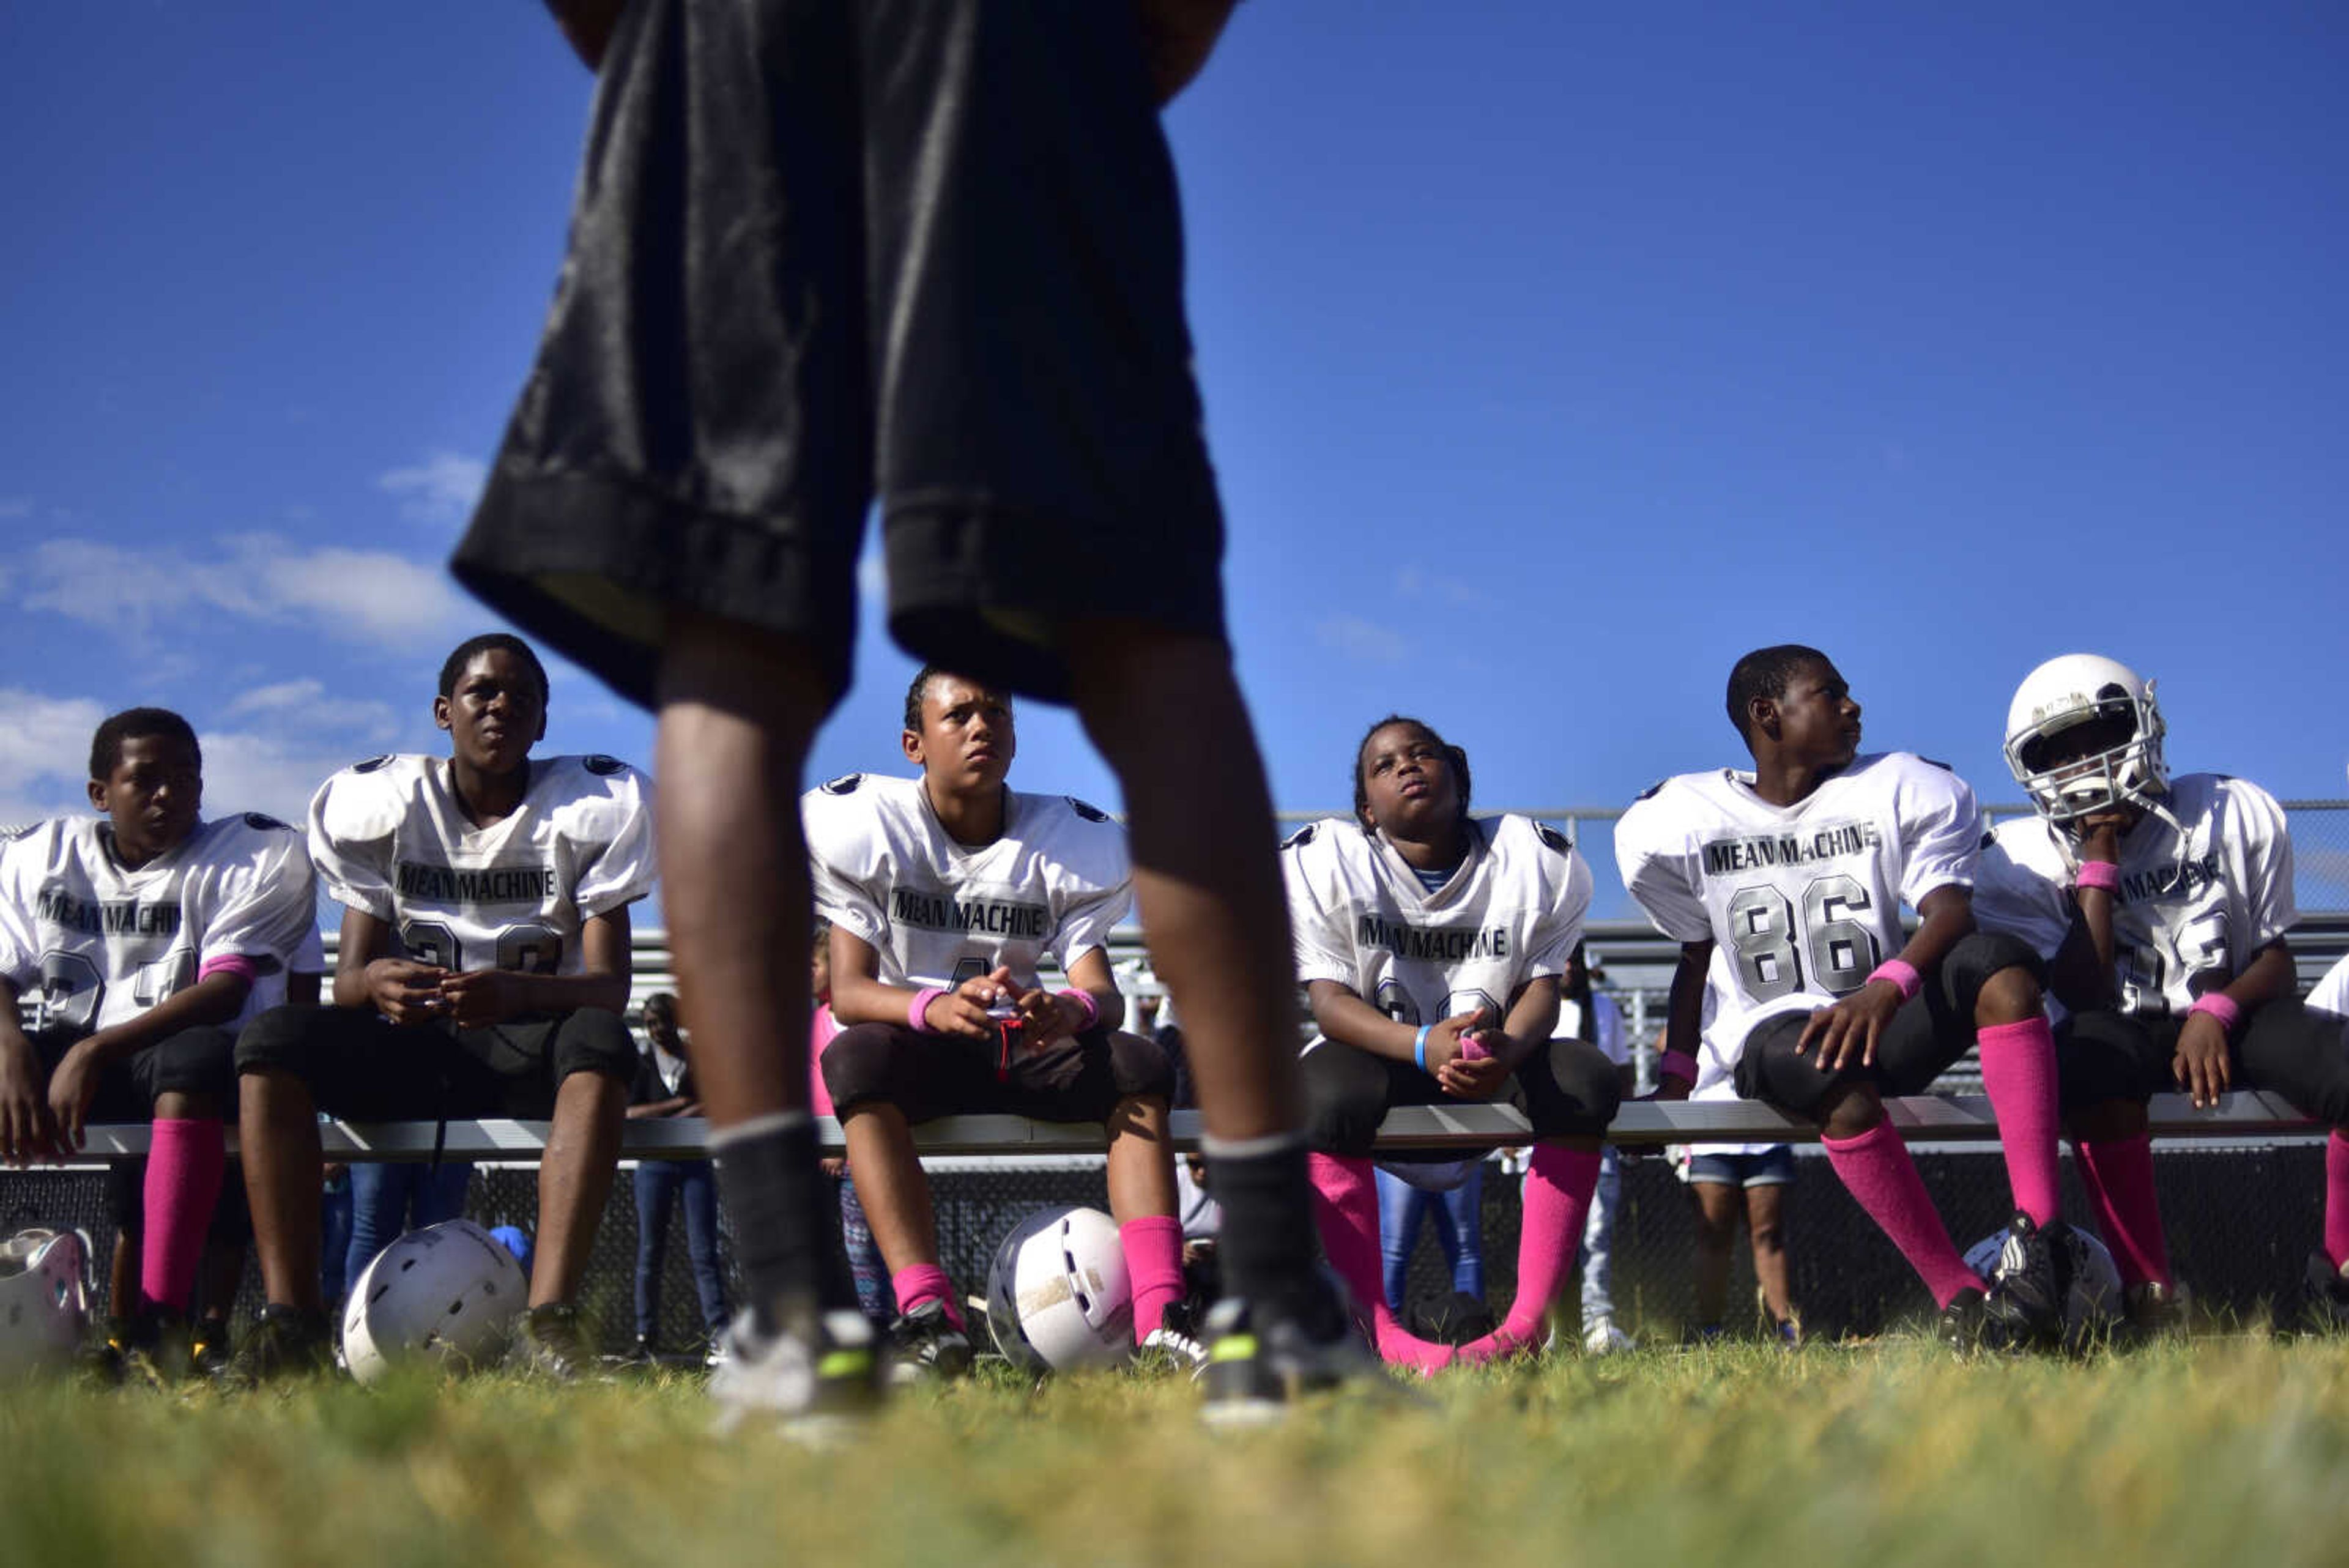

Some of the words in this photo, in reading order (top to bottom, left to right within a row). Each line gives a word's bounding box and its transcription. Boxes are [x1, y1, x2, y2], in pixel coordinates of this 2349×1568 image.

[1712, 841, 1776, 872] MEAN
[1778, 823, 1880, 864] MACHINE
[400, 861, 456, 897] MEAN
[459, 871, 555, 901] MACHINE
[951, 902, 1043, 936] MACHINE
[1727, 873, 1881, 1005] 86
